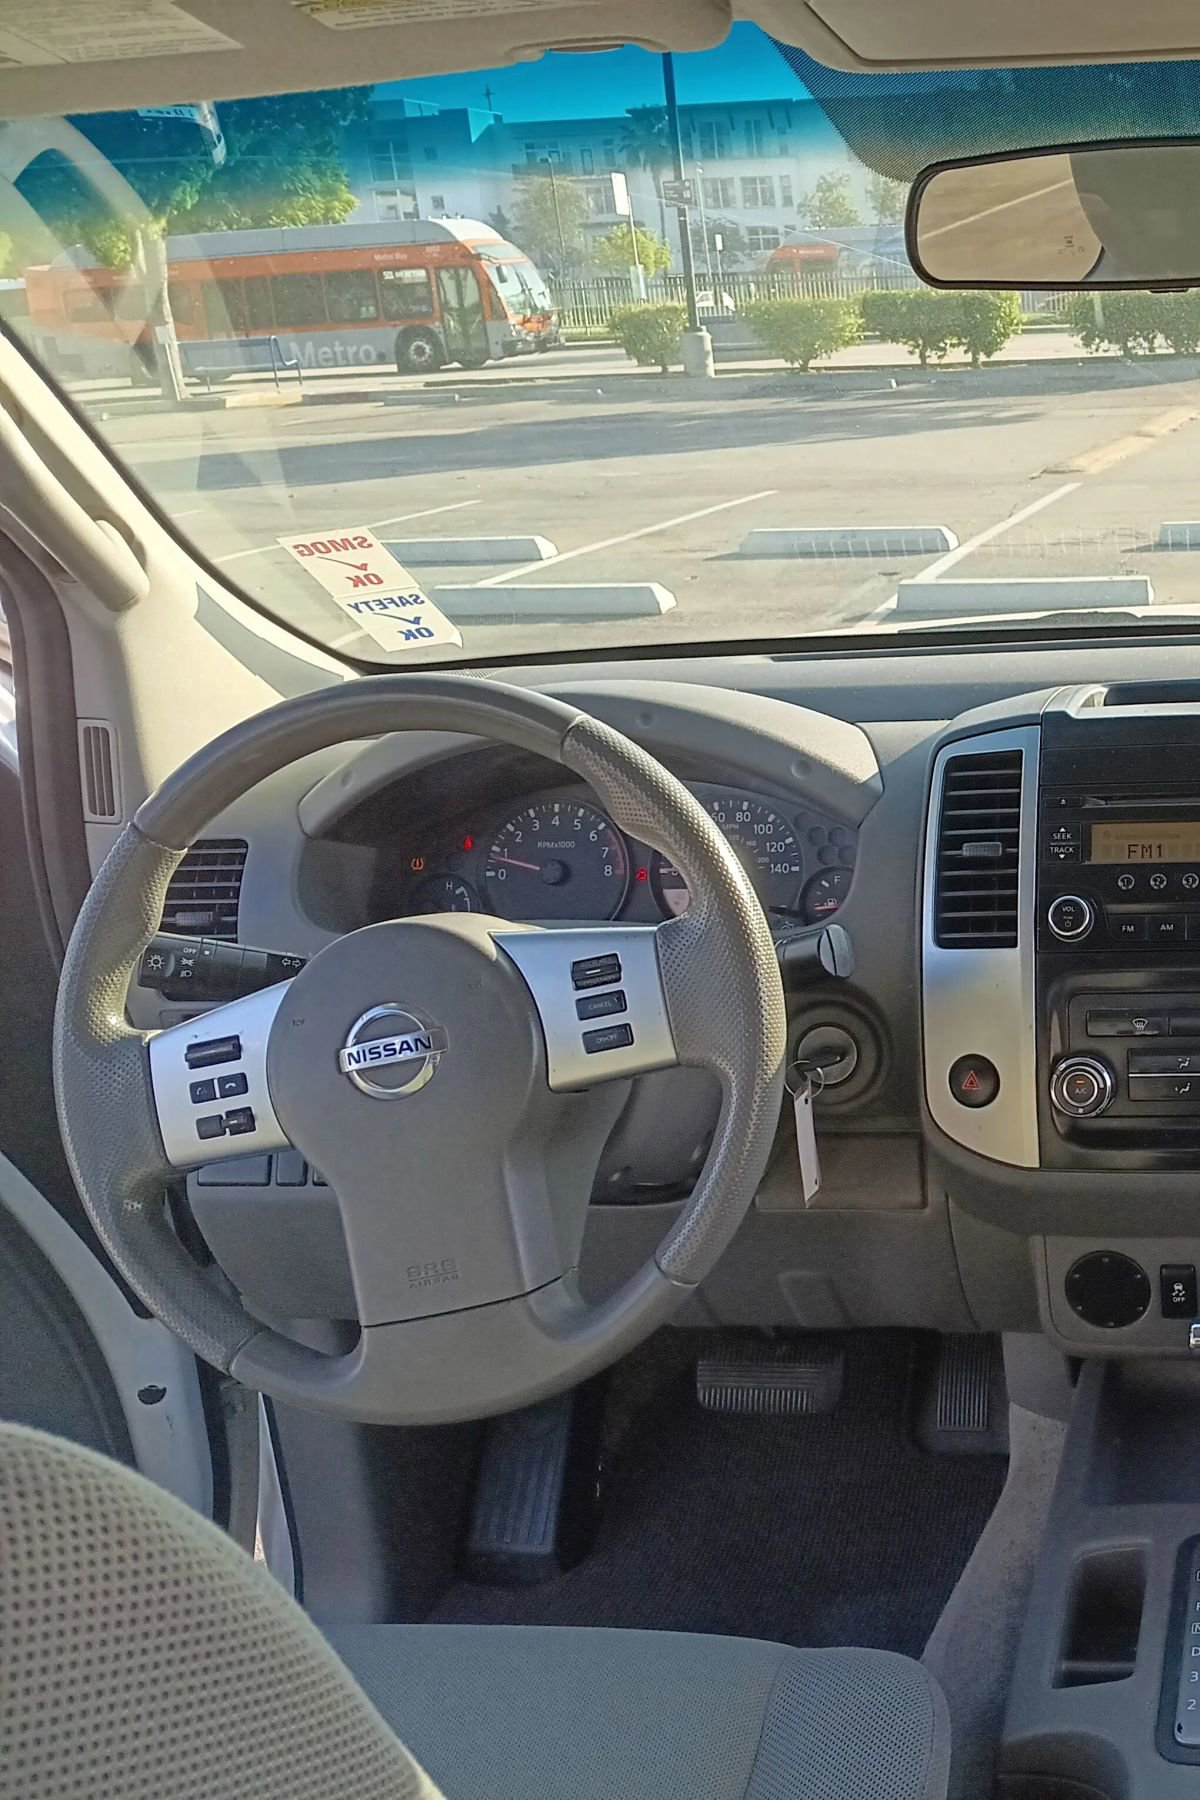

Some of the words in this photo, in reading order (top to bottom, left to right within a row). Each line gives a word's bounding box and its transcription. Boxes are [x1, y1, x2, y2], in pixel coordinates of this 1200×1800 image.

[289, 341, 377, 367] Metro
[551, 815, 560, 827] 4
[735, 811, 751, 822] 80
[532, 819, 540, 831] 3
[573, 819, 581, 830] 5
[753, 823, 774, 834] 100
[514, 831, 522, 843] 2
[590, 829, 598, 842] 6
[1052, 832, 1073, 840] SEEK
[503, 847, 508, 859] 1
[601, 846, 609, 859] 7
[766, 842, 785, 853] 120
[1049, 846, 1075, 854] TRACK
[1127, 843, 1163, 859] FM1
[498, 868, 507, 880] 0
[603, 864, 613, 877] 8
[769, 863, 790, 874] 140
[834, 875, 841, 885] F
[446, 881, 453, 891] H
[183, 947, 197, 955] OFF
[347, 1036, 433, 1067] NISSAN
[1190, 1672, 1199, 1682] 3
[1187, 1700, 1196, 1710] 2
